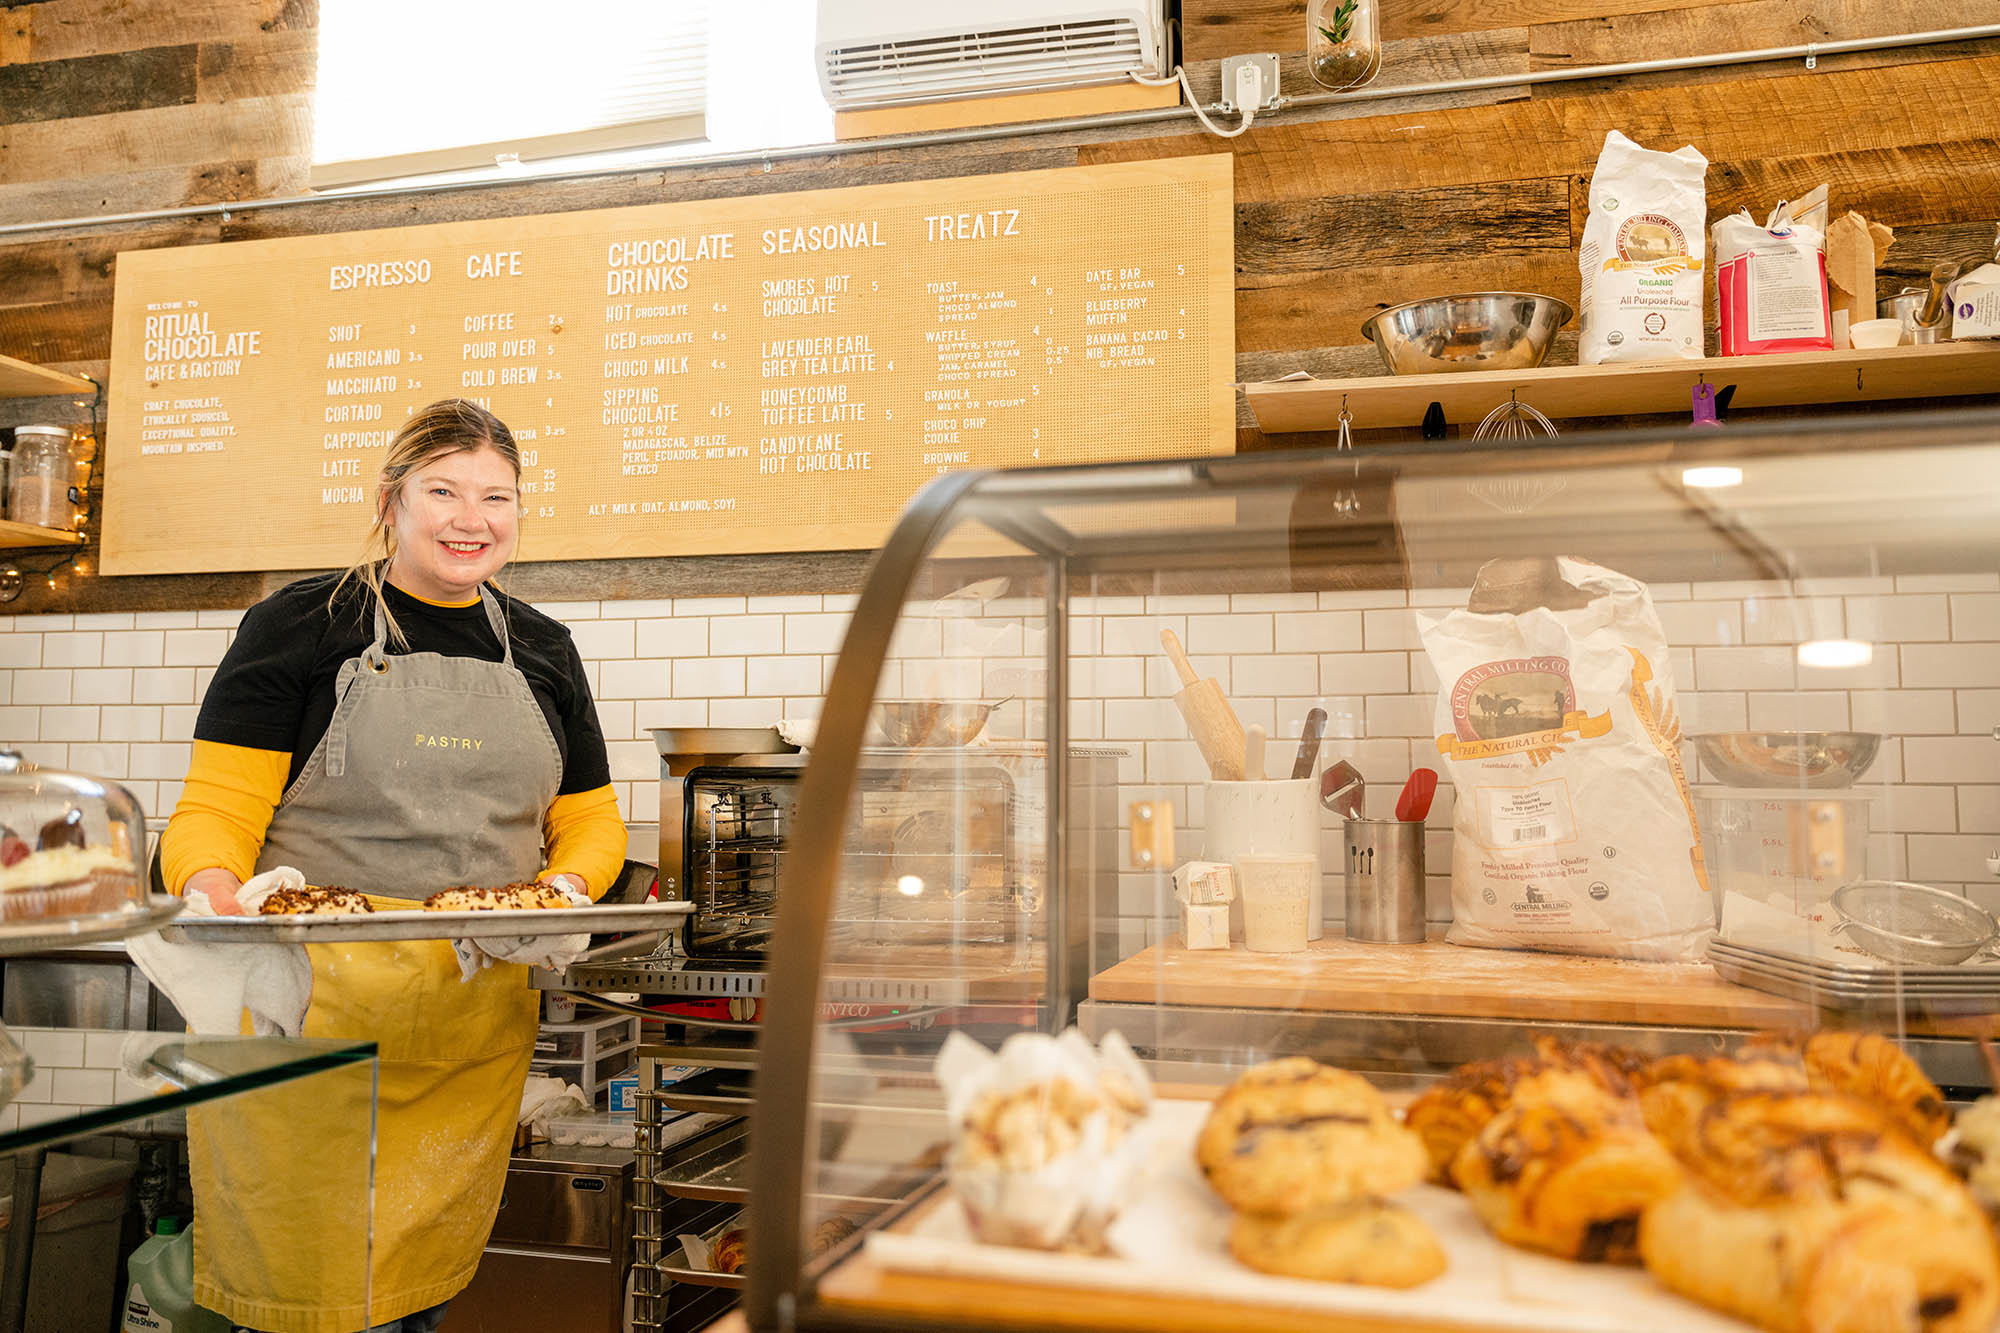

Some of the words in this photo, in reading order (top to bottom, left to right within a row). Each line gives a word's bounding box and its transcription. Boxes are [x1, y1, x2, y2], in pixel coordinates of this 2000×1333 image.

[924, 209, 1020, 242] TREATZ
[762, 221, 886, 256] SEASONAL
[608, 234, 734, 268] CHOCOLATE
[330, 258, 432, 290] ESPRESSO
[466, 252, 522, 279] CAFE
[1086, 270, 1112, 282] DATE
[1120, 268, 1140, 280] BAR
[1178, 264, 1184, 275] 5
[606, 266, 689, 296] DRINKS
[762, 278, 815, 298] SMORES
[824, 274, 850, 294] HOT
[872, 280, 878, 292] 5
[926, 282, 958, 294] TOAST
[1030, 276, 1036, 287] 4
[1120, 280, 1154, 290] VEGAN
[1638, 278, 1673, 286] ORGANIC
[187, 300, 199, 308] TO
[763, 296, 836, 318] CHOCOLATE
[938, 294, 980, 302] BUTTER,
[938, 304, 970, 312] CHOCO
[978, 300, 1016, 310] ALMOND
[1086, 298, 1147, 312] BLUEBERRY
[1620, 296, 1632, 304] All
[1634, 296, 1668, 306] Purpose
[1670, 296, 1689, 306] Flour
[464, 312, 514, 332] COFFEE
[606, 304, 632, 322] HOT
[636, 304, 688, 318] CHOCOLATE
[938, 312, 977, 322] SPREAD
[1086, 312, 1126, 326] MUFFIN
[1179, 308, 1184, 316] 4
[145, 312, 215, 338] RITUAL
[328, 324, 362, 342] SHOT
[410, 324, 416, 335] 3
[926, 330, 967, 342] WAFFLE
[1034, 324, 1039, 336] 4
[605, 332, 636, 350] ICED
[640, 332, 694, 346] CHOCOLATE
[938, 342, 980, 352] BUTTER,
[984, 340, 1016, 349] SYRUP
[1086, 332, 1126, 346] BANANA
[1133, 330, 1168, 342] CACAO
[1178, 328, 1184, 340] 5
[144, 331, 261, 362] CHOCOLATE
[464, 342, 496, 360] POUR
[502, 338, 536, 357] OVER
[548, 346, 554, 355] 5
[762, 338, 832, 360] LAVENDER
[836, 336, 872, 354] EARL
[938, 352, 980, 362] WHIPPED
[986, 350, 1020, 358] CREAM
[1046, 346, 1070, 354] 0.25
[1086, 347, 1102, 360] NIB
[1110, 344, 1144, 358] BREAD
[327, 348, 400, 368] AMERICANO
[604, 360, 648, 378] CHOCO
[654, 356, 688, 376] MILK
[762, 358, 798, 378] GREY
[802, 356, 828, 375] TEA
[833, 354, 876, 374] LATTE
[888, 360, 894, 371] 4
[964, 360, 1008, 370] CARAMEL
[1046, 356, 1062, 364] 0.5
[1120, 358, 1155, 367] VEGAN
[145, 364, 176, 382] CAFE
[180, 363, 188, 380] &
[190, 360, 242, 378] FACTORY
[462, 369, 495, 388] COLD
[502, 367, 538, 385] BREW
[938, 372, 970, 381] CHOCO
[976, 369, 1016, 379] SPREAD
[327, 376, 397, 396] MACCHIATO
[924, 388, 970, 402] GRANOLA
[1032, 384, 1039, 396] 5
[546, 398, 552, 408] 4
[604, 386, 658, 406] SIPPING
[761, 384, 847, 407] HONEYCOMB
[937, 402, 960, 411] MILK
[966, 400, 980, 408] OR
[986, 398, 1026, 408] YOGURT
[144, 400, 169, 411] CRAFT
[325, 404, 382, 423] CORTADO
[602, 404, 678, 424] CHOCOLATE
[762, 406, 816, 426] TOFFEE
[822, 403, 866, 424] LATTE
[886, 409, 892, 420] 5
[144, 414, 187, 426] ETHICALLY
[924, 419, 957, 432] CHOCO
[963, 417, 986, 429] CHIP
[142, 428, 194, 440] EXCEPTIONAL
[624, 428, 630, 438] 2
[632, 427, 644, 436] OR
[656, 425, 668, 436] OZ
[924, 432, 960, 444] COOKIE
[1032, 428, 1039, 439] 3
[142, 443, 182, 456] MOUNTAIN
[624, 437, 688, 450] MADAGASCAR,
[694, 434, 727, 447] BELIZE
[760, 434, 843, 455] CANDYCANE
[522, 450, 538, 466] GO
[622, 452, 649, 464] PERU,
[656, 449, 700, 462] ECUADOR,
[706, 448, 724, 459] MID
[728, 446, 748, 458] MTN
[760, 456, 787, 474] HOT
[796, 452, 872, 474] CHOCOLATE
[924, 452, 969, 464] BROWNIE
[1032, 448, 1039, 459] 4
[322, 459, 360, 477] LATTE
[544, 469, 556, 480] 25
[622, 464, 658, 476] MEXICO
[322, 488, 364, 504] MOCHA
[544, 482, 556, 492] 32
[540, 506, 554, 518] 0.5
[589, 504, 606, 516] ALT
[613, 503, 636, 514] MILK
[668, 500, 711, 512] ALMOND,
[714, 498, 736, 510] SOY)
[1455, 670, 1488, 720] CENTRAL
[1488, 662, 1549, 676] MILLING
[415, 734, 483, 750] PASTRY
[1458, 746, 1479, 756] THE
[1481, 737, 1538, 753] NATURAL
[1501, 862, 1524, 870] Milled
[1560, 857, 1588, 866] Quality
[1568, 868, 1588, 876] Flour
[1514, 902, 1541, 910] CENTRAL
[140, 1316, 160, 1328] Shine
